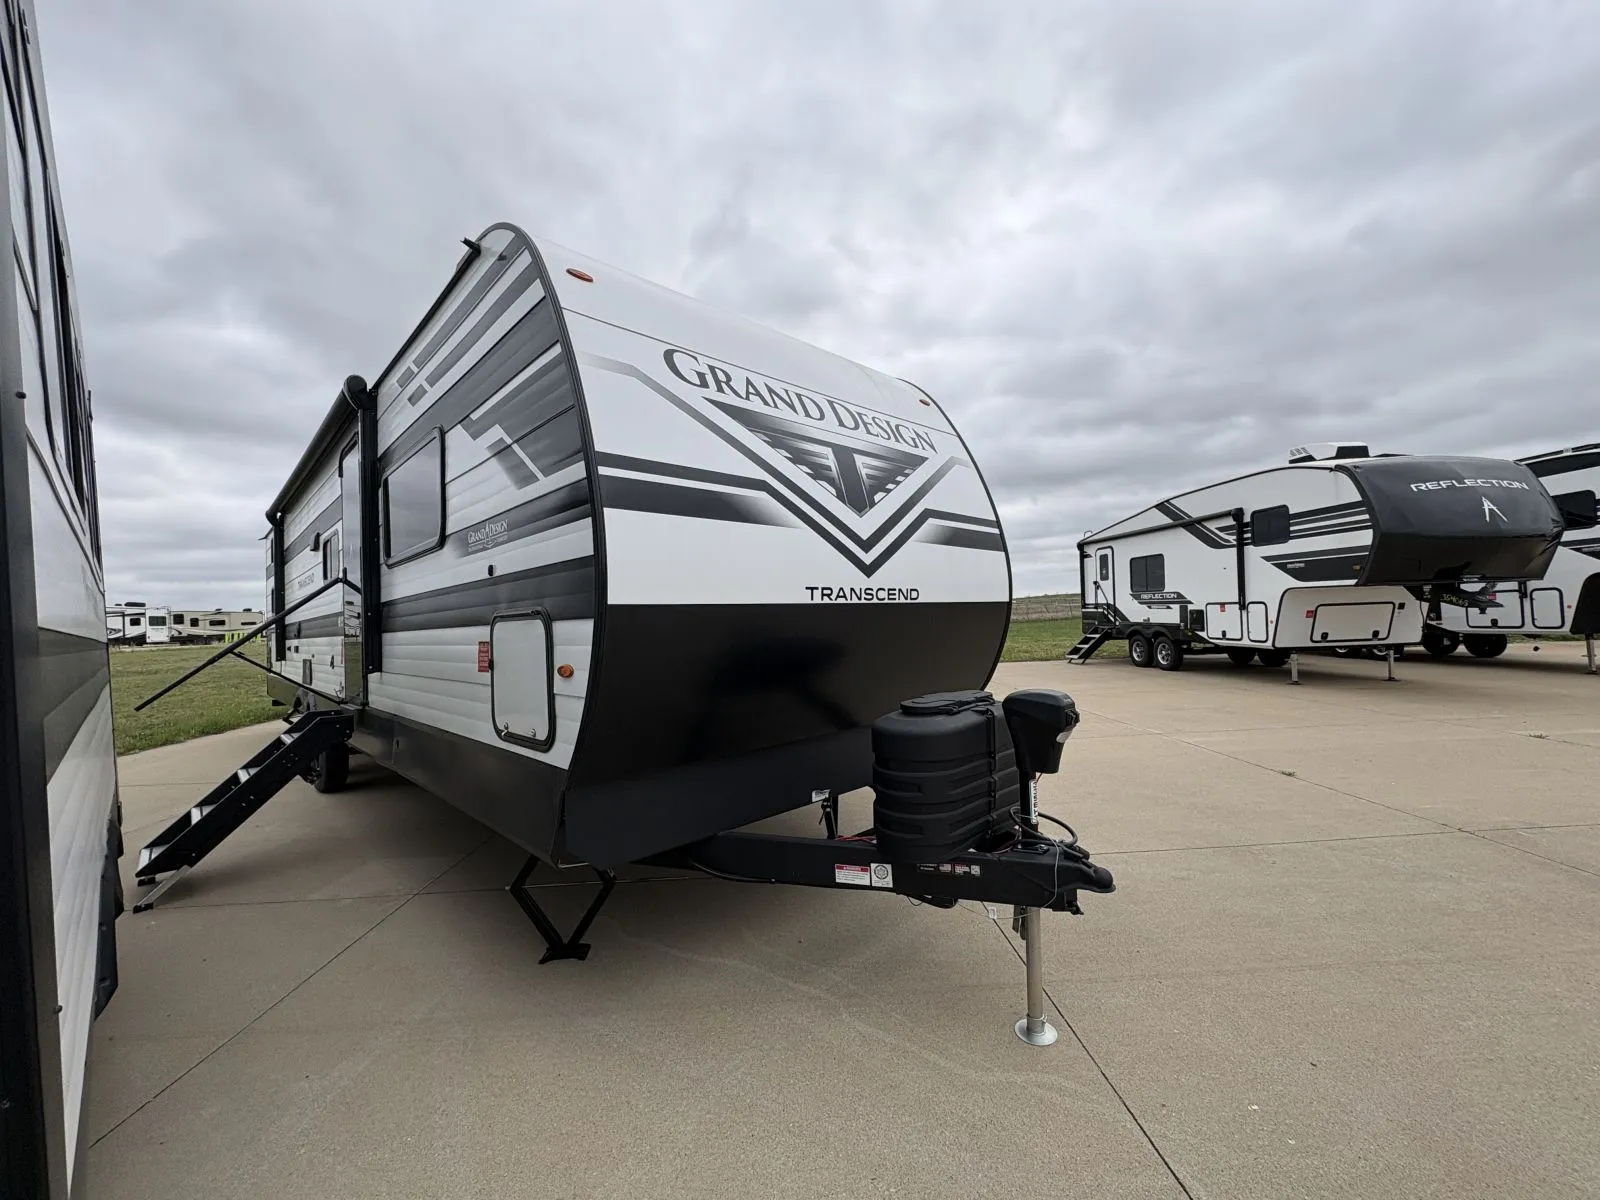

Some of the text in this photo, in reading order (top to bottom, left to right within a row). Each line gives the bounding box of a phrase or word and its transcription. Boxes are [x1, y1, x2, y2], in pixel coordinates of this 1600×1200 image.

[663, 348, 938, 454] GRAND DESIGN
[1410, 478, 1530, 492] REFLECTION
[805, 586, 920, 601] TRANSCEND
